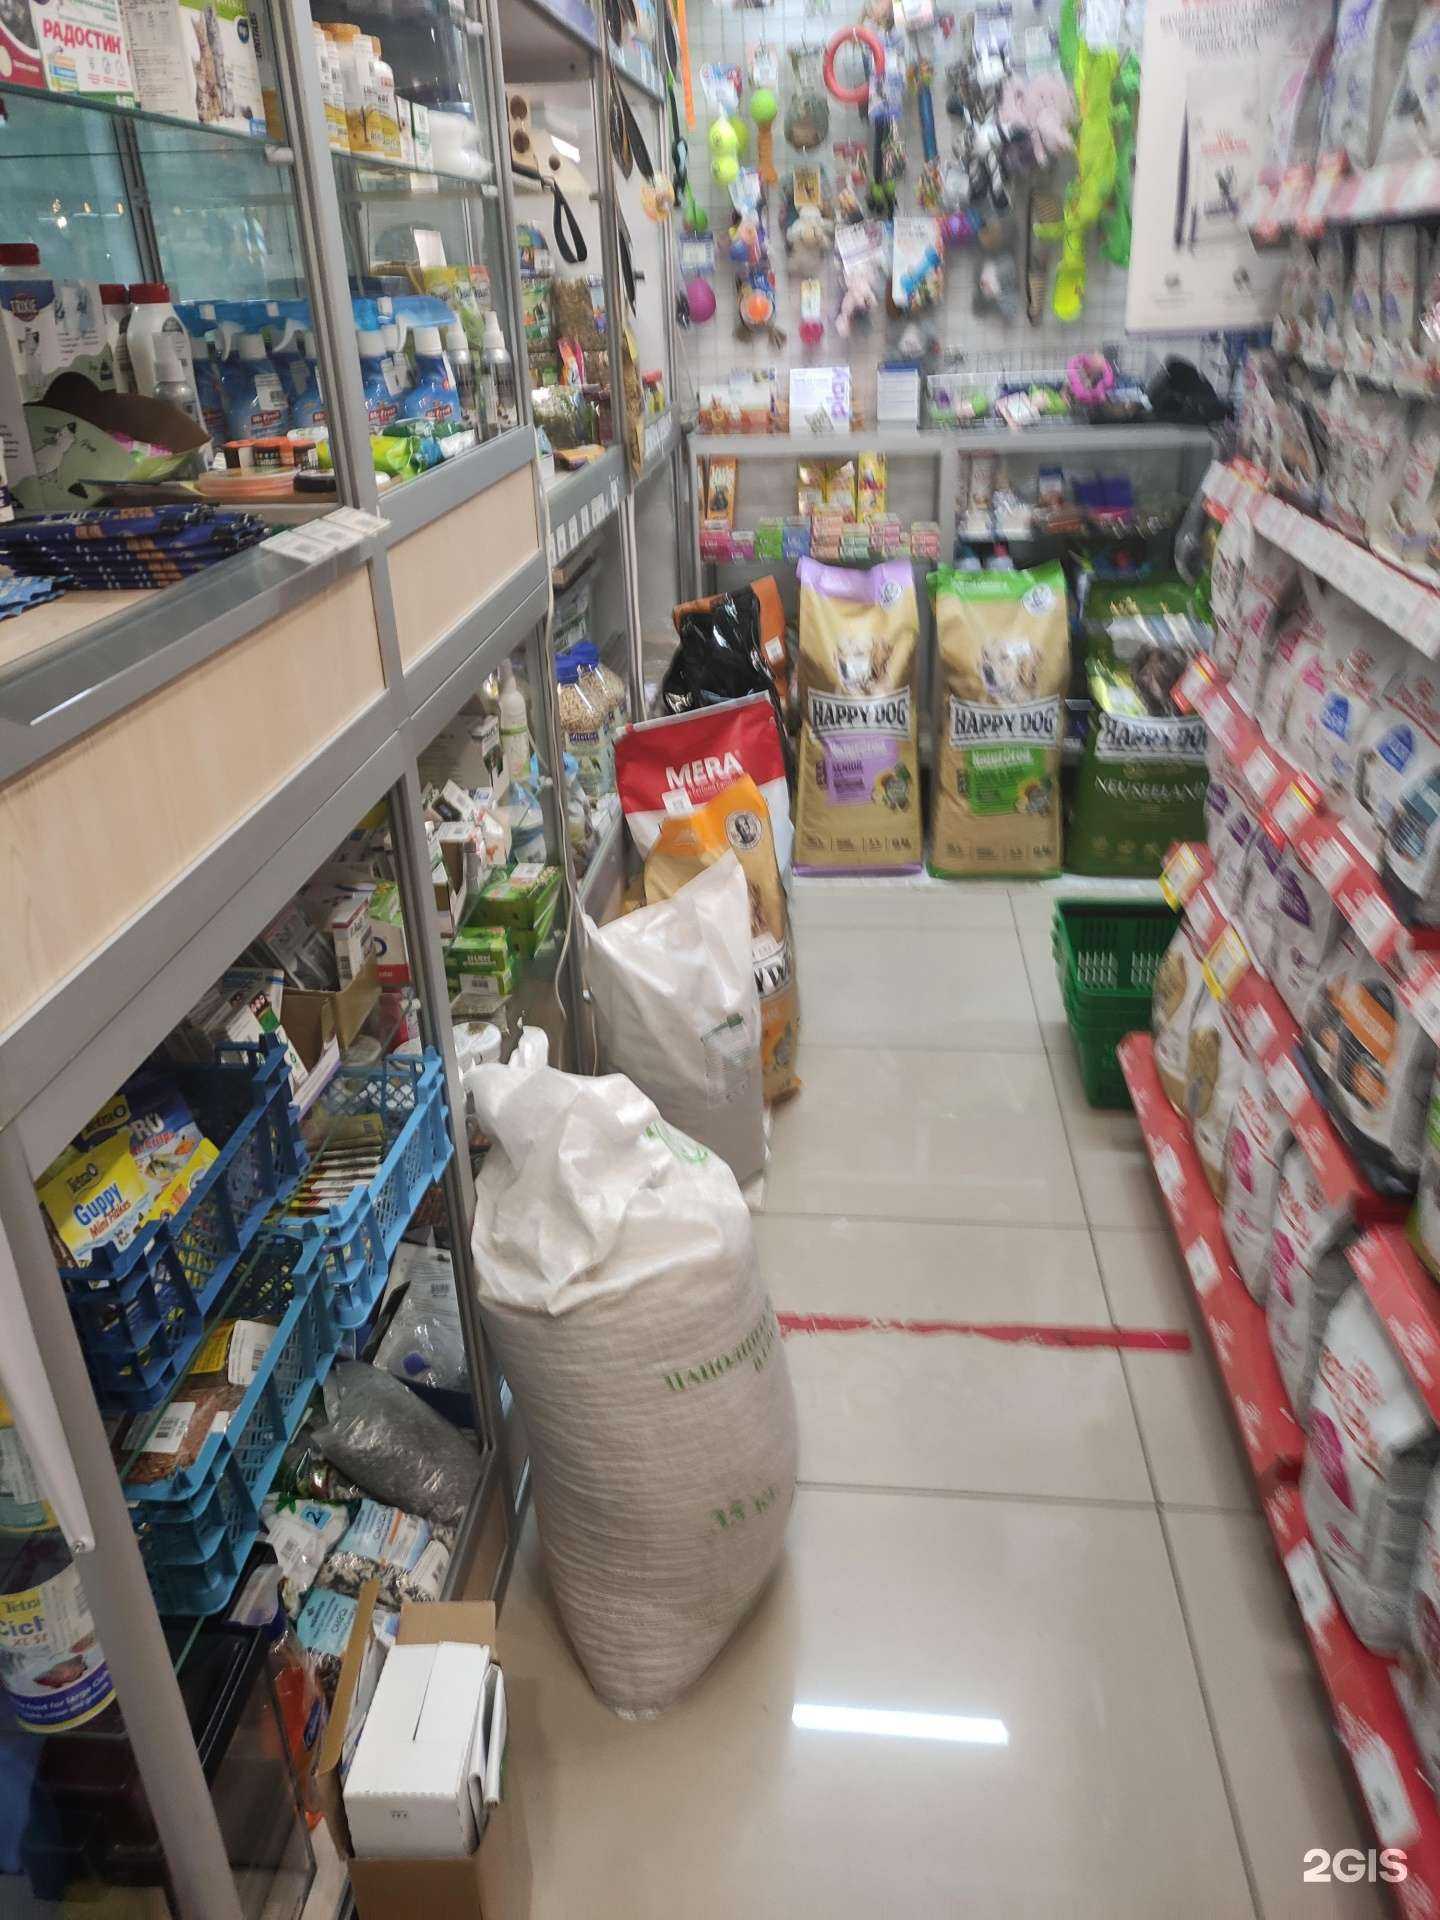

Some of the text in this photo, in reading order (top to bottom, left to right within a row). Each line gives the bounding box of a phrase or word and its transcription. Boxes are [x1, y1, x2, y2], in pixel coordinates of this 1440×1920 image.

[43, 19, 121, 54] РАДОСТИН
[812, 697, 907, 727] HAPPY DOG
[954, 706, 1055, 736] HAPPY DOG
[665, 751, 745, 791] MERA
[73, 1182, 125, 1226] Guppy
